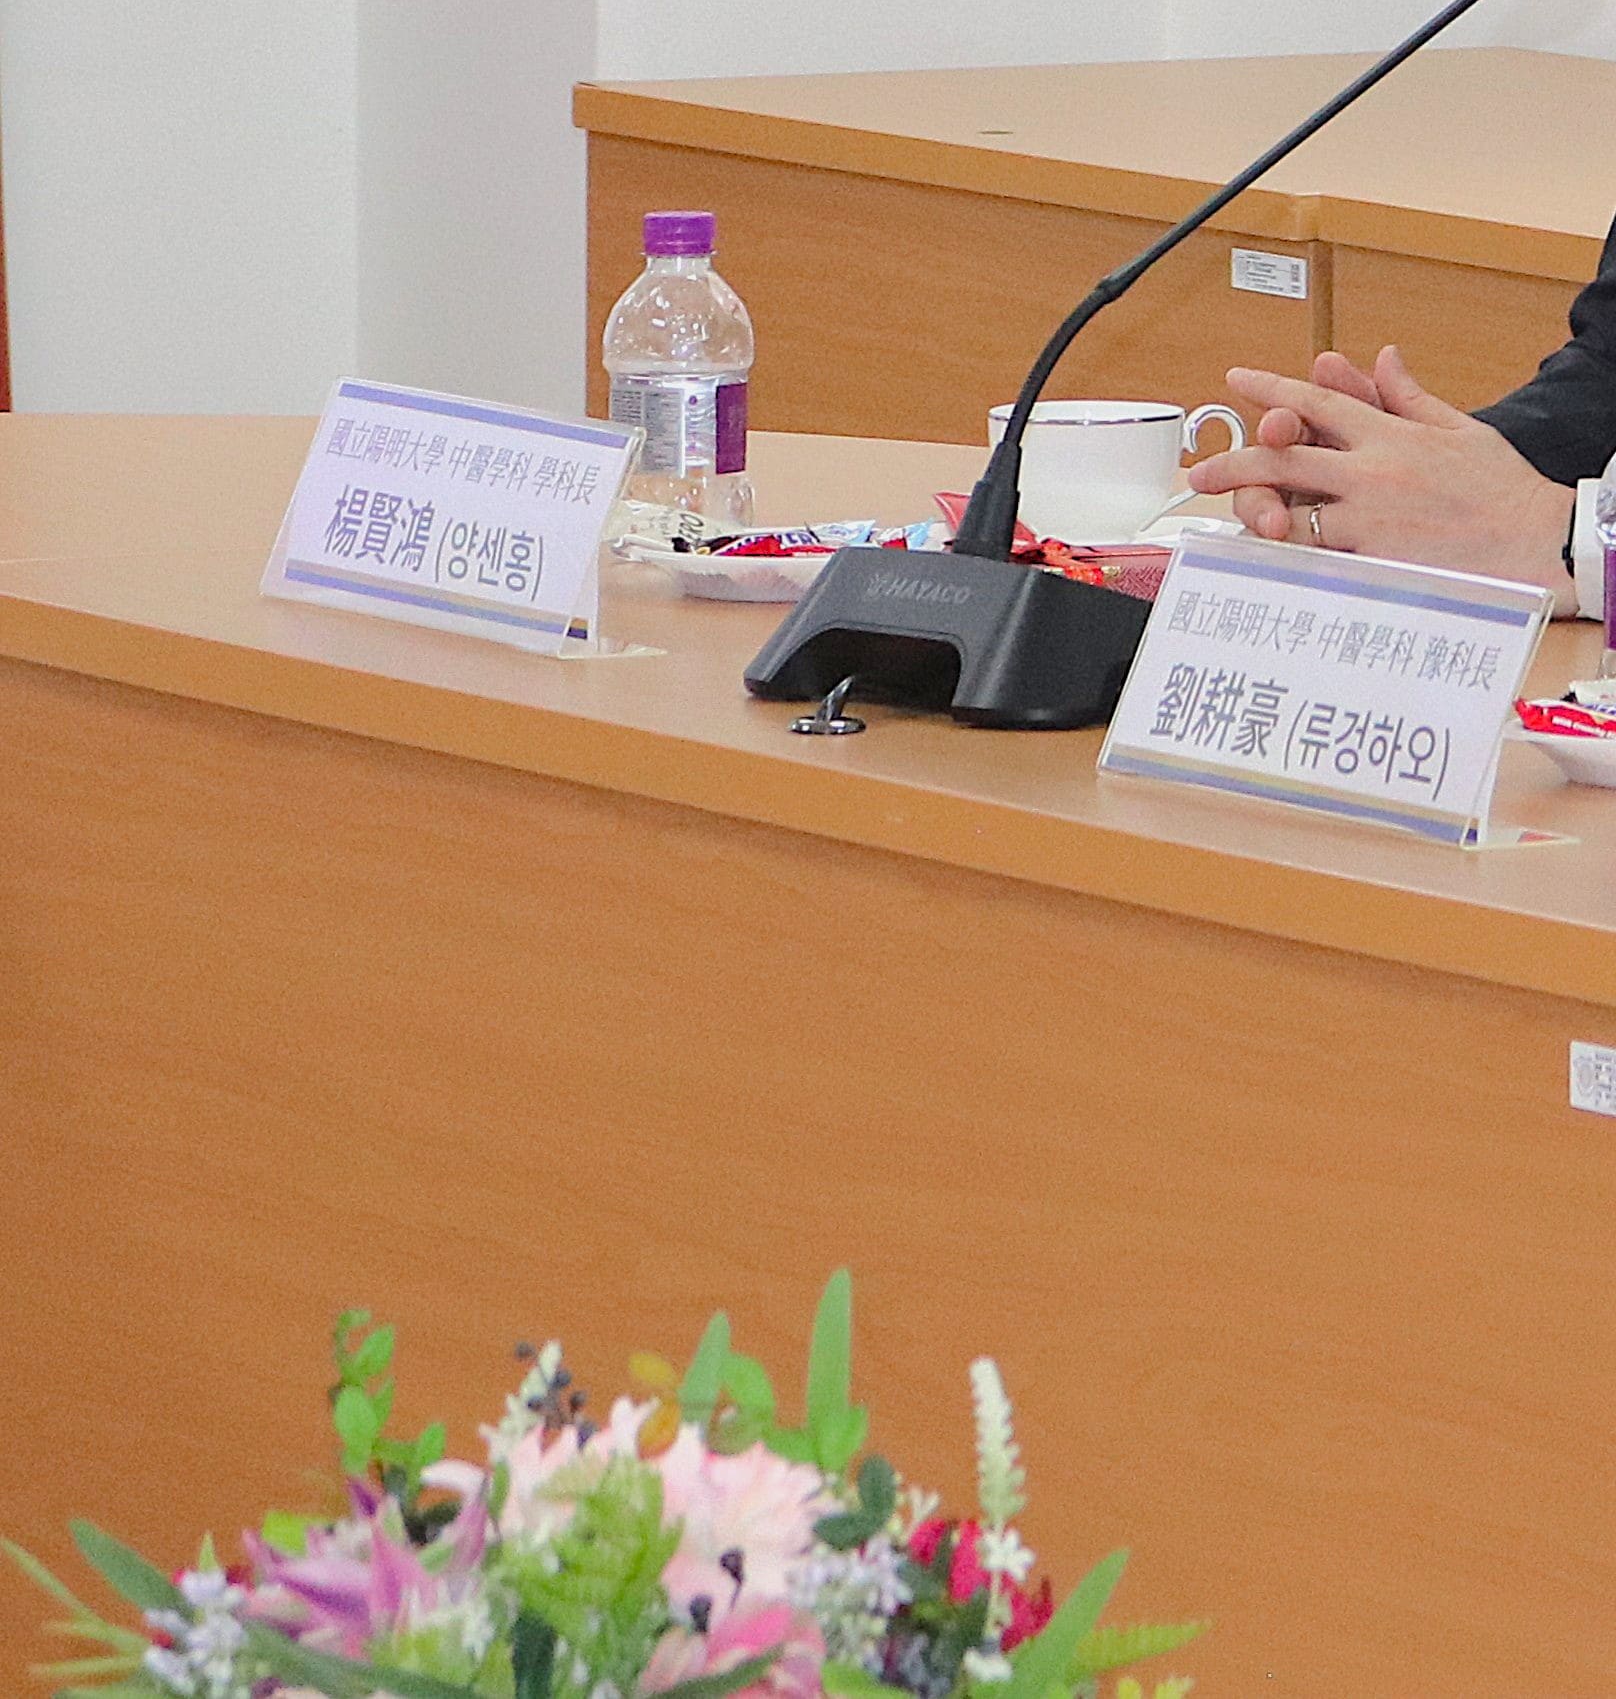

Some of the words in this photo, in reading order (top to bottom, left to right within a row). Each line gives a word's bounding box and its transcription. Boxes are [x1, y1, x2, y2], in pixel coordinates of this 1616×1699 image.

[327, 418, 448, 475] 國立陽明大學
[449, 440, 533, 493] 中醫學科
[324, 484, 436, 572] 楊賢鴻
[434, 517, 544, 602] (양센홍)
[1167, 591, 1319, 649] 國立陽明大學
[1317, 618, 1419, 676] 中醫學科
[1150, 662, 1289, 759] 劉耕豪
[1283, 699, 1451, 801] (류겅하오)
